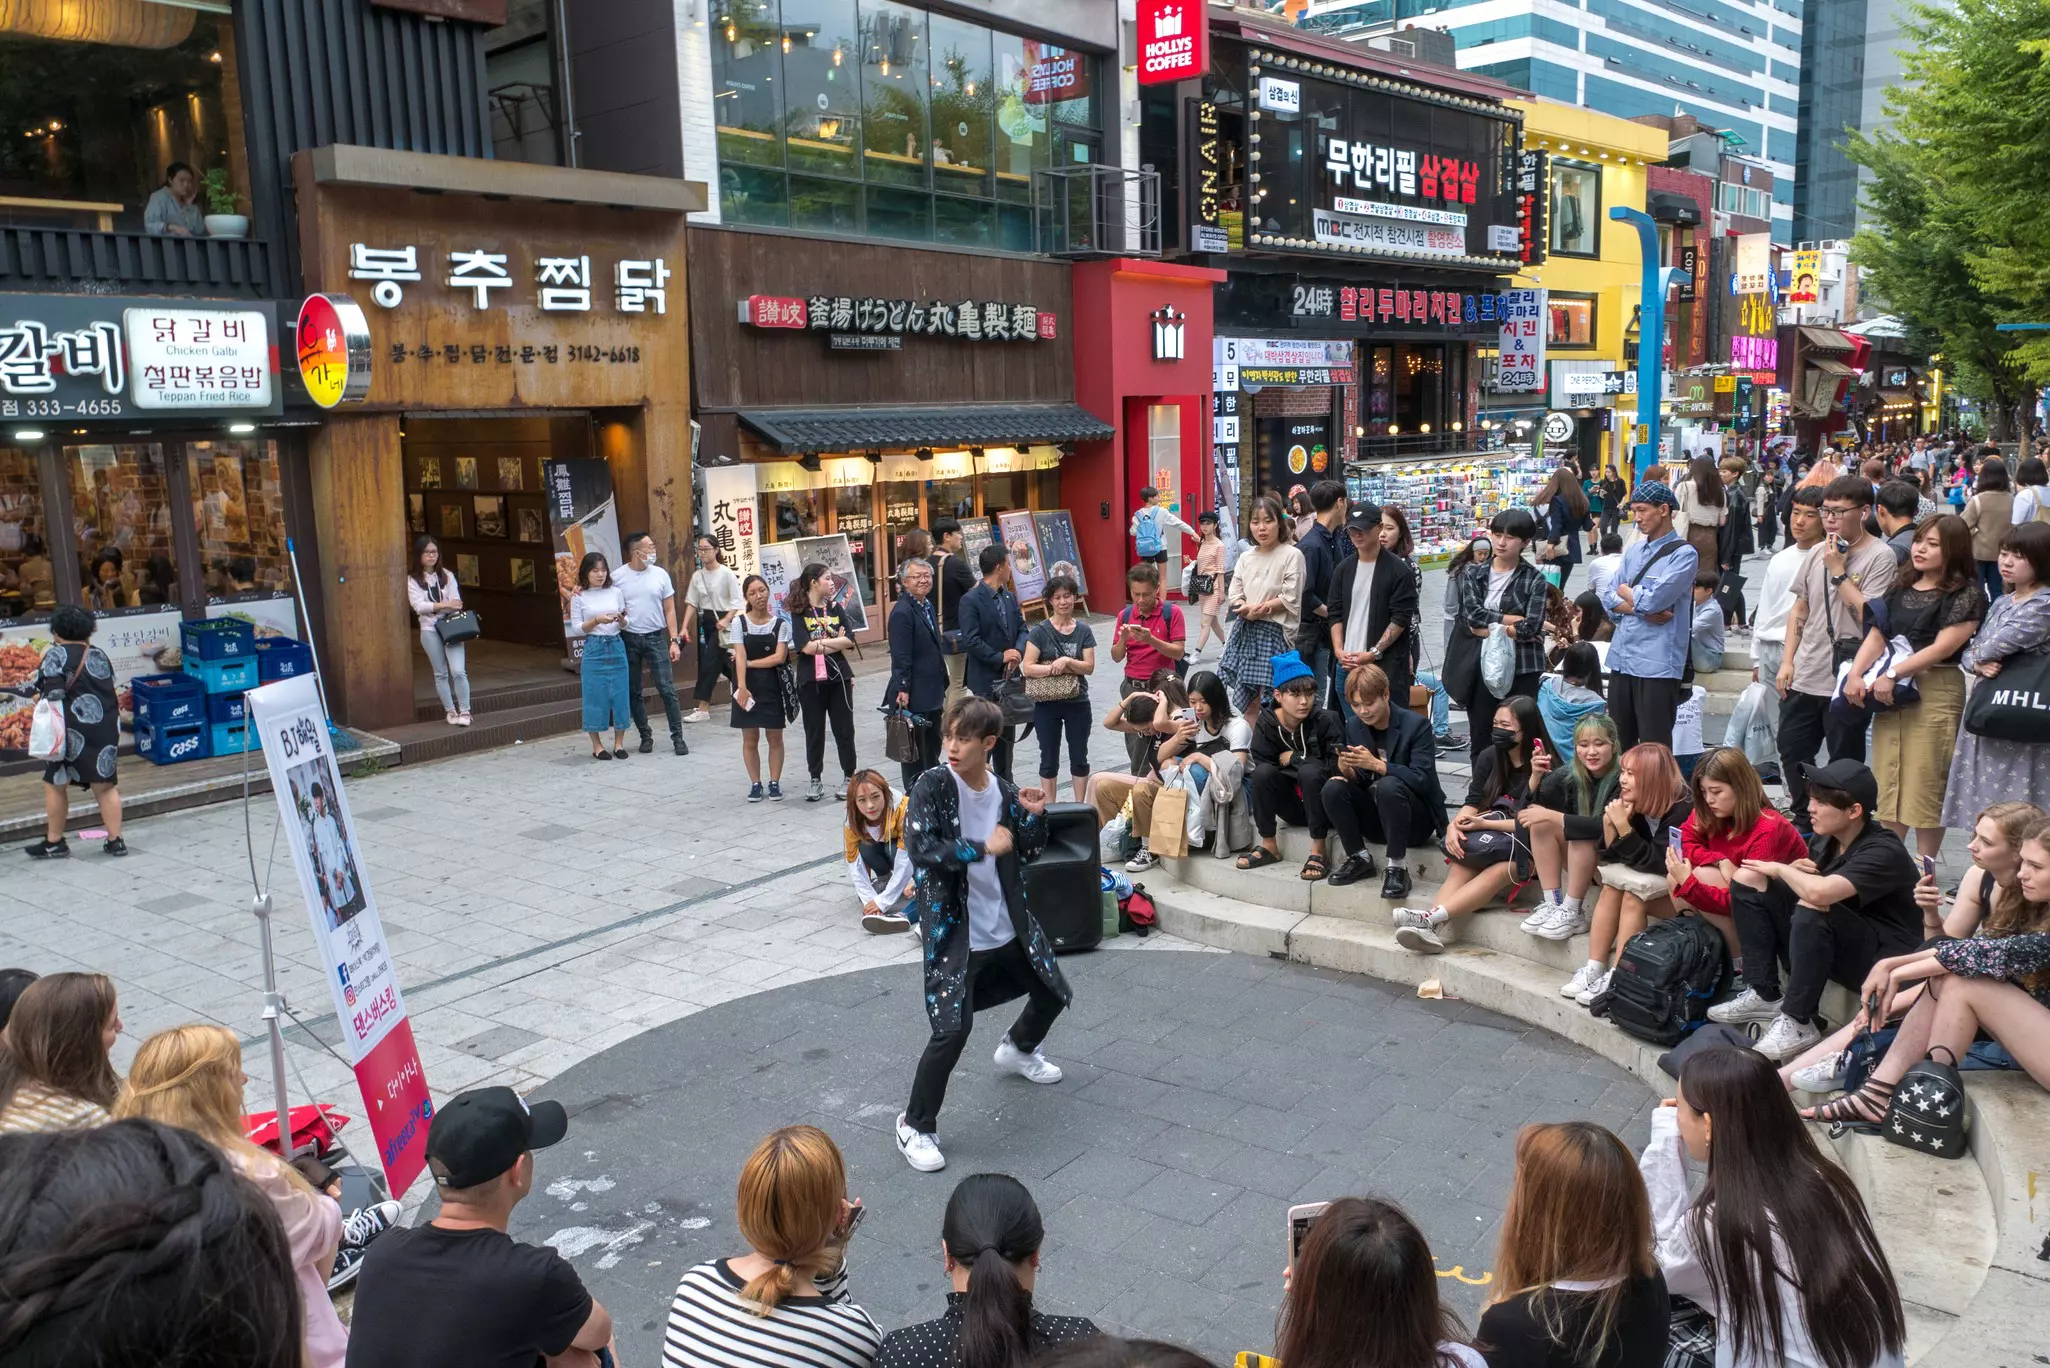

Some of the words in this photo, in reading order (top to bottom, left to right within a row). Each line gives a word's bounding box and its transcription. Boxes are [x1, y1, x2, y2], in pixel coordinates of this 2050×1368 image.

[1145, 36, 1193, 58] HOLLYS
[1145, 52, 1193, 73] COFFEE
[1268, 86, 1289, 103] 삼겹의
[1290, 90, 1298, 105] 신
[1326, 137, 1418, 196] 무한리필
[1418, 153, 1480, 205] 삼겹살
[1344, 201, 1360, 212] 삼겹살
[1317, 218, 1351, 238] MBC
[1353, 223, 1384, 243] 전지적
[1387, 226, 1425, 248] 참견시점
[1427, 230, 1464, 250] 촬영장소
[348, 243, 671, 315] 봉추찜닭
[1293, 286, 1334, 316] 24時
[1508, 291, 1535, 304] 찰리
[809, 295, 925, 332] 釜揚げうどん
[1503, 320, 1537, 338] 치킨
[165, 345, 209, 357] Chicken
[212, 345, 239, 357] Galbi
[1514, 338, 1525, 351] &
[567, 345, 641, 363] 3142-6618
[1501, 353, 1536, 370] 포차
[143, 364, 263, 389] 철판볶음밥
[1298, 369, 1331, 384] 무한리필
[1330, 369, 1353, 383] 삼겹살
[1501, 371, 1535, 386] 24時
[158, 391, 197, 406] Teppan
[199, 391, 226, 403] Fried
[227, 391, 251, 403] Rice
[26, 401, 122, 416] 333-4655
[353, 983, 397, 1040] 댄스버스킹
